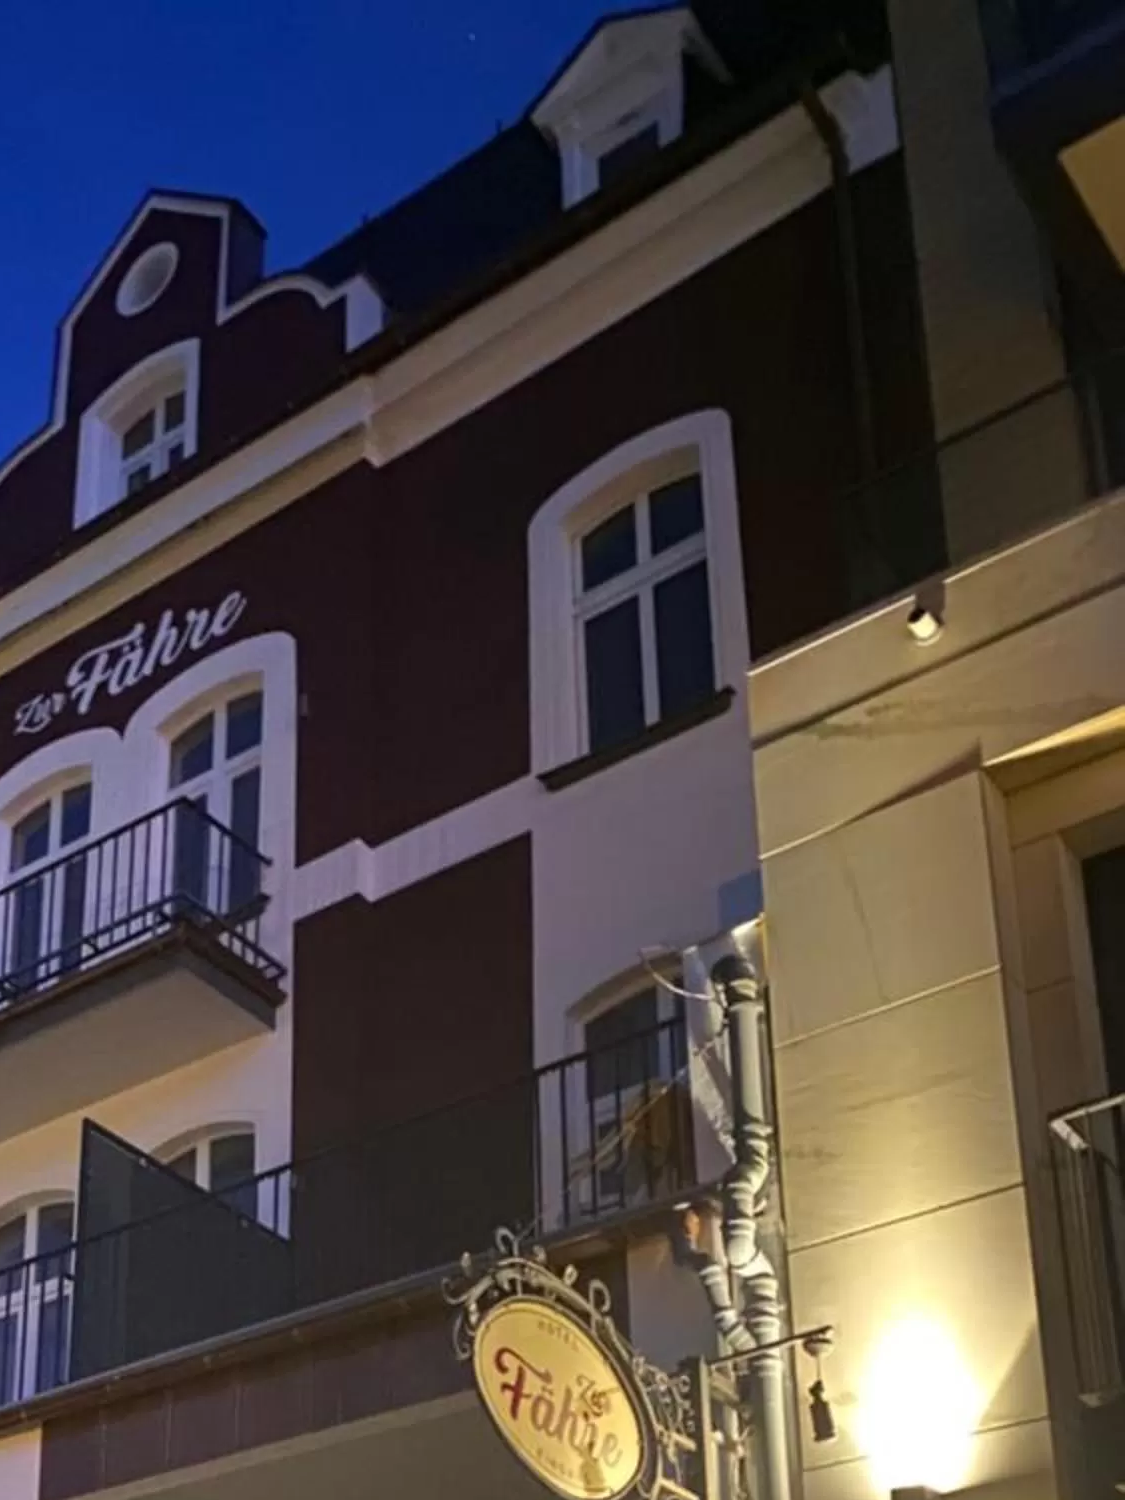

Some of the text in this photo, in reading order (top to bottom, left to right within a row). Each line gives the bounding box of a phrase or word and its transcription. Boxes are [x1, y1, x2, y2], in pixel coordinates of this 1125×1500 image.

[13, 590, 247, 735] Zur Fähre
[493, 1346, 623, 1468] Fähre
